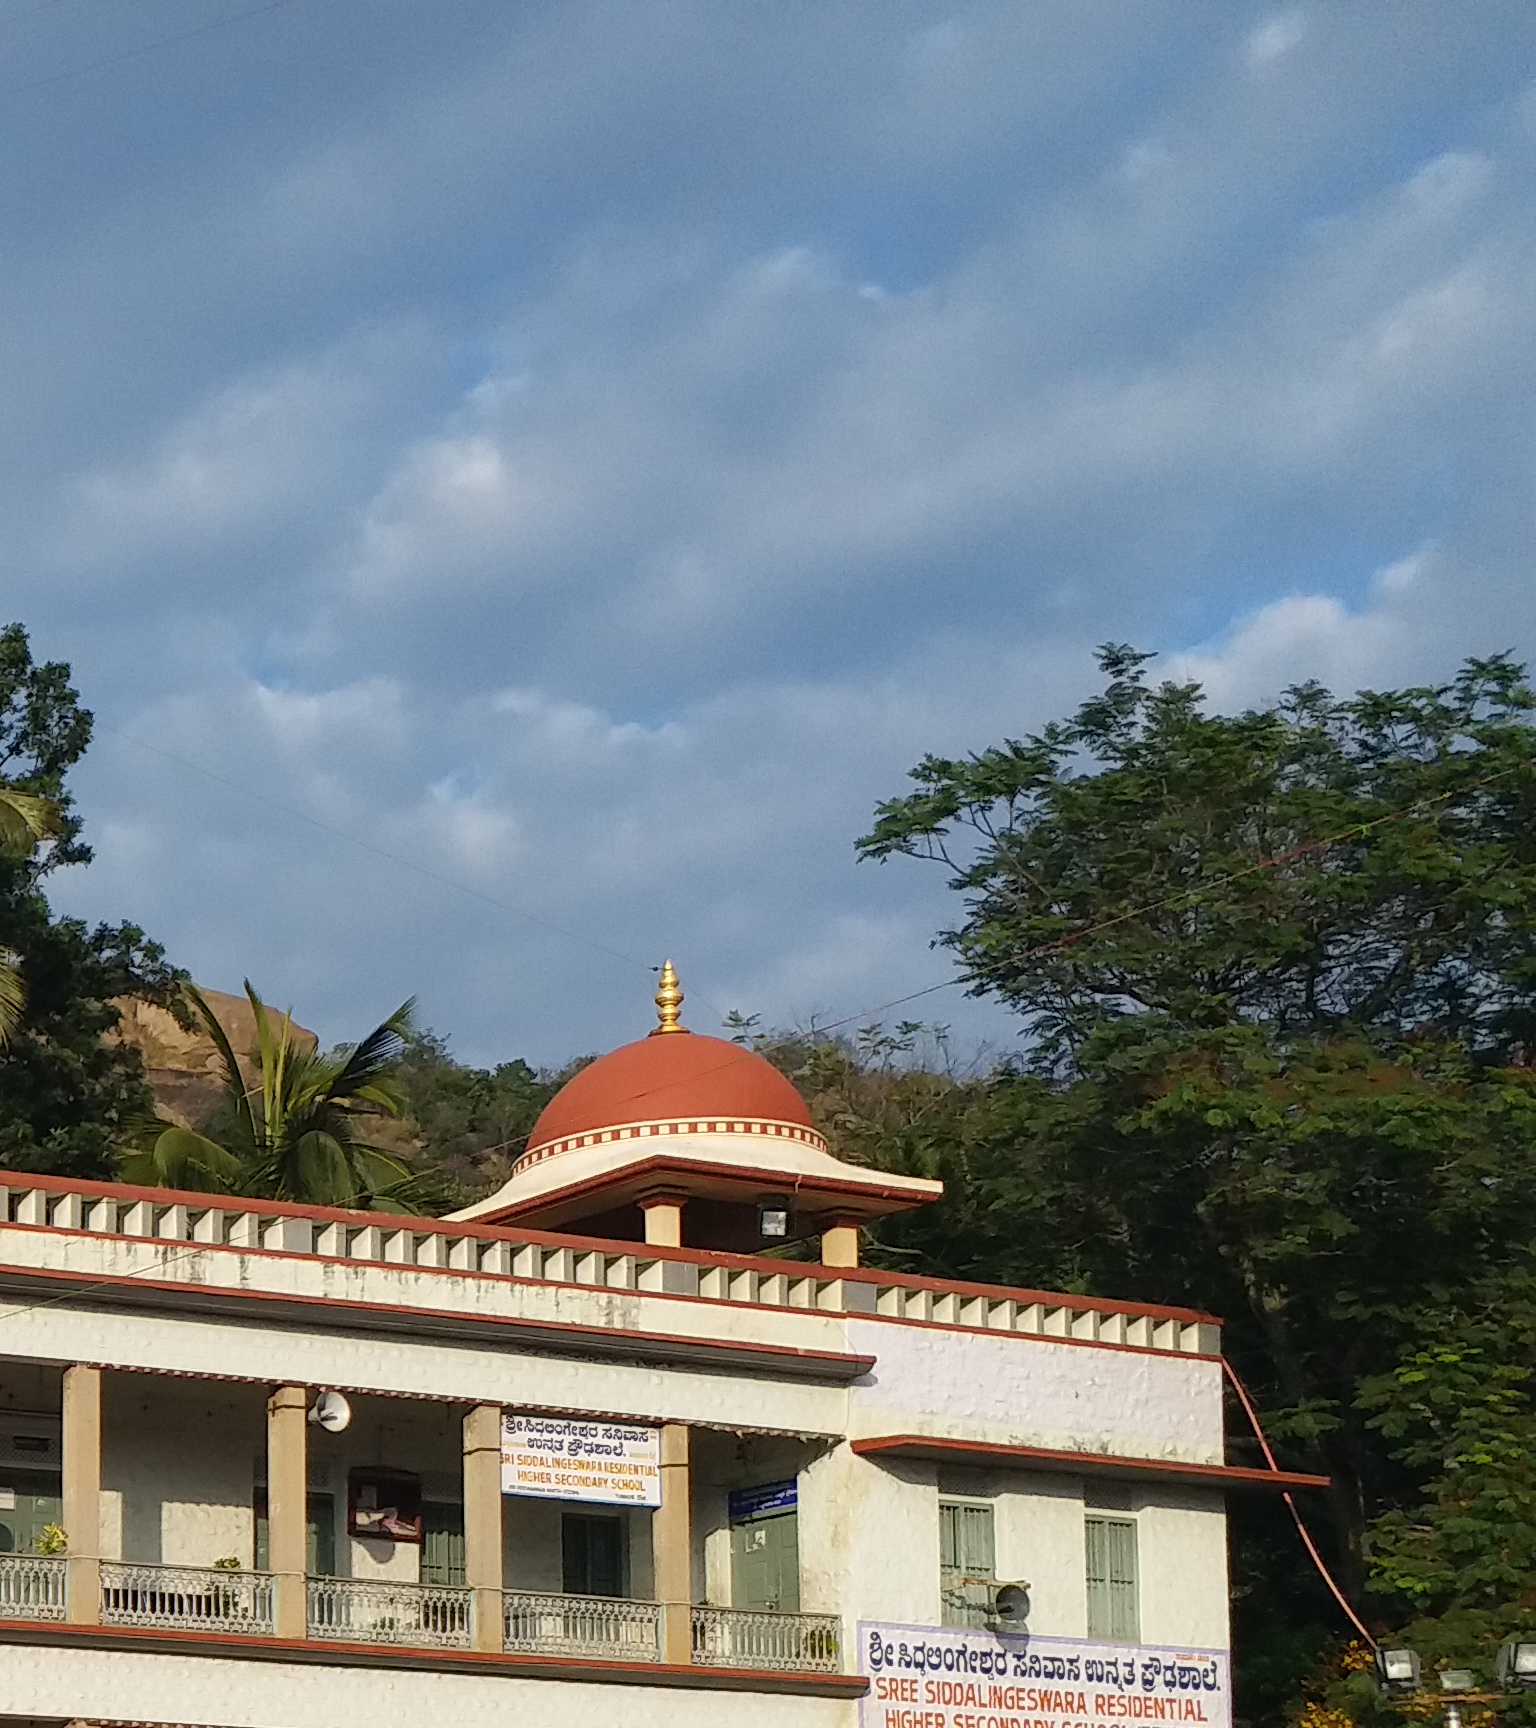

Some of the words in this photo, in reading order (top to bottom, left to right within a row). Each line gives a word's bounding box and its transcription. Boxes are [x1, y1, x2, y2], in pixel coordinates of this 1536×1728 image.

[505, 1415, 523, 1434] ಶ್ರೀ
[517, 1455, 602, 1473] SIDDALINGESWARA
[604, 1463, 658, 1477] RESIDENTIAL
[517, 1470, 552, 1484] HIGHER
[554, 1473, 608, 1489] SECONDARY
[611, 1478, 646, 1492] SCHOOL
[869, 1631, 895, 1672] ಶ್ರೀ
[1012, 1648, 1081, 1682] ಸನಿವಾಸ
[1085, 1656, 1137, 1692] ಉನ್ನತ
[875, 1677, 919, 1704] SREE
[924, 1680, 1088, 1716] SIDDALINGESWARA
[1094, 1693, 1209, 1723] RESIDENTIAL
